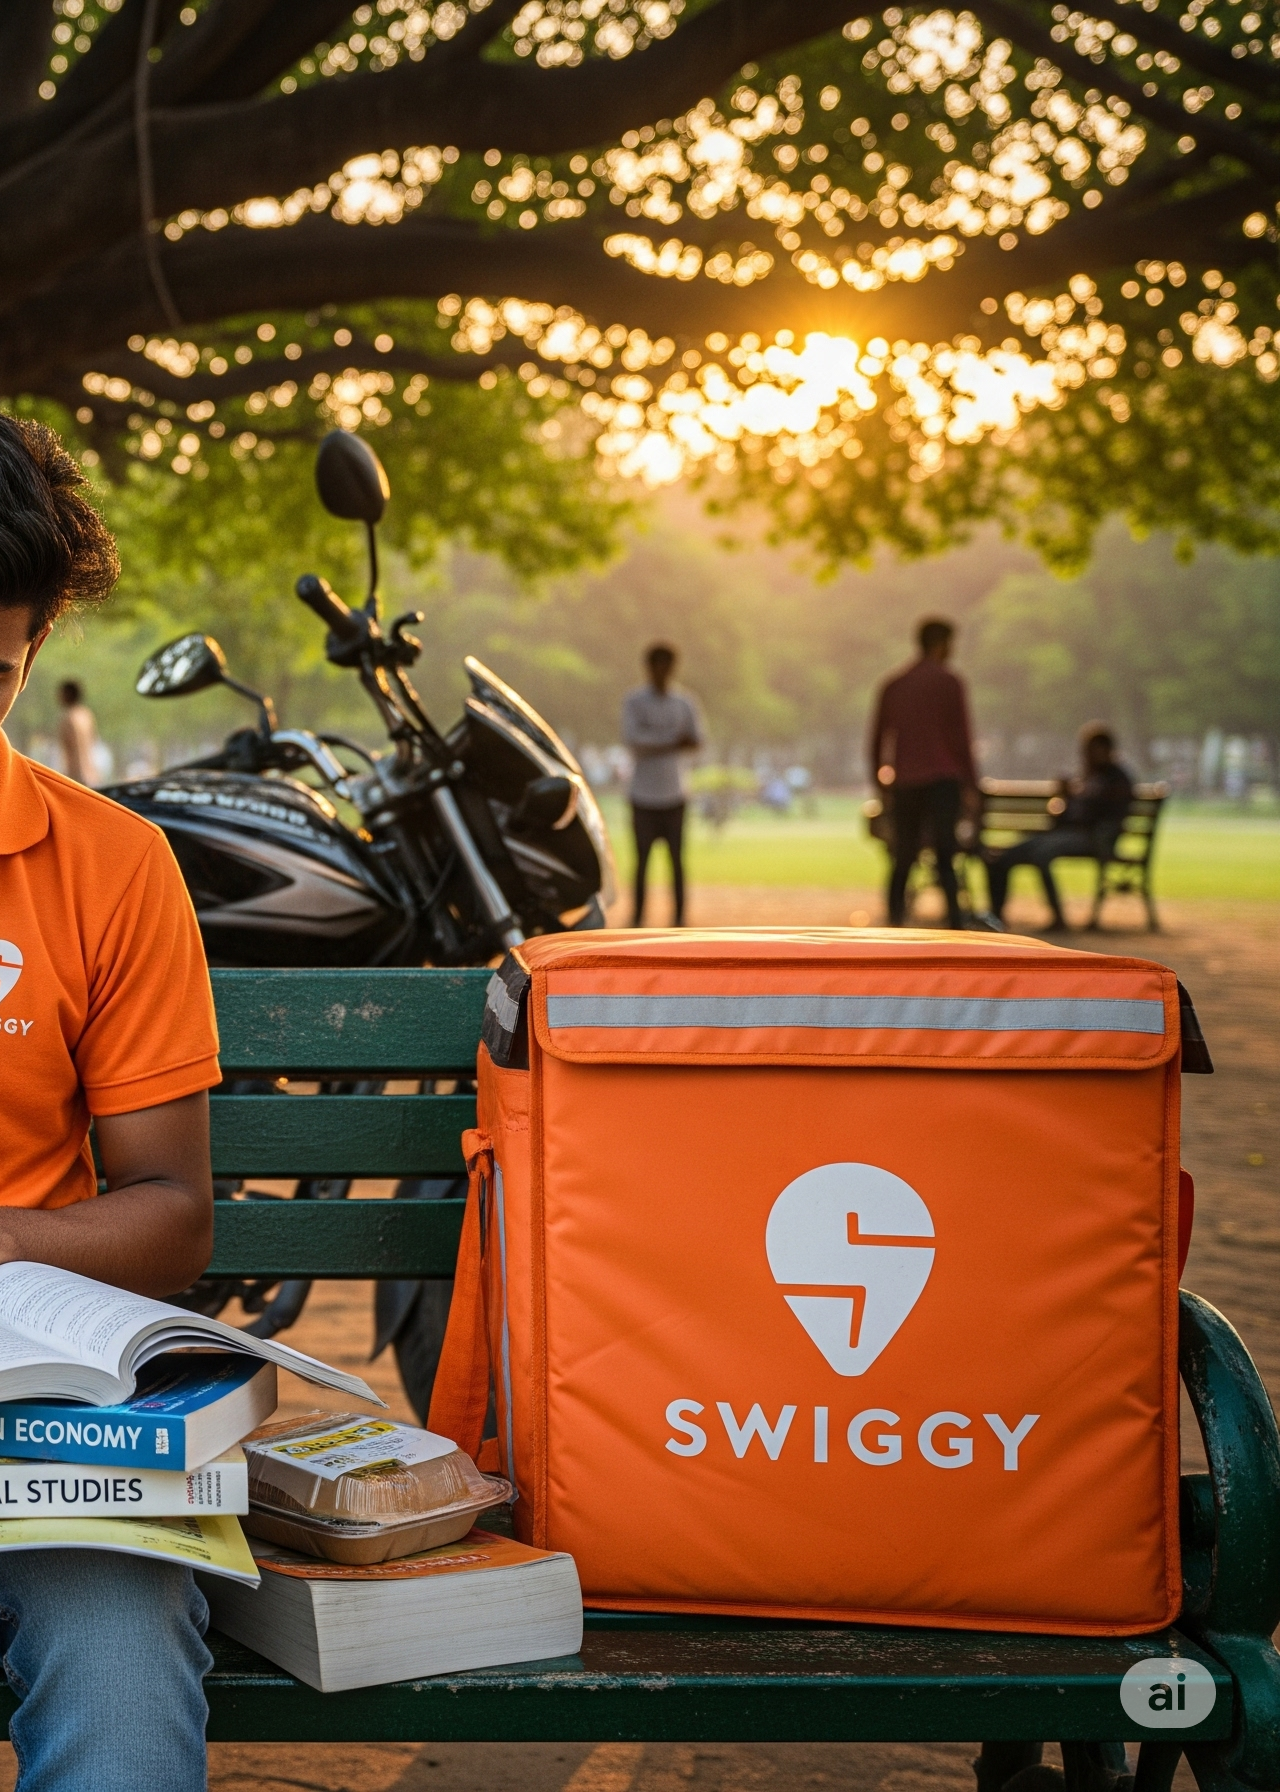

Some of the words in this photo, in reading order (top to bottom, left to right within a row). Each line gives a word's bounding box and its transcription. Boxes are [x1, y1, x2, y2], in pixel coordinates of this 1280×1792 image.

[15, 1418, 142, 1450] ECONOMY
[665, 1398, 1041, 1471] SWIGGY
[26, 1478, 144, 1504] STUDIES
